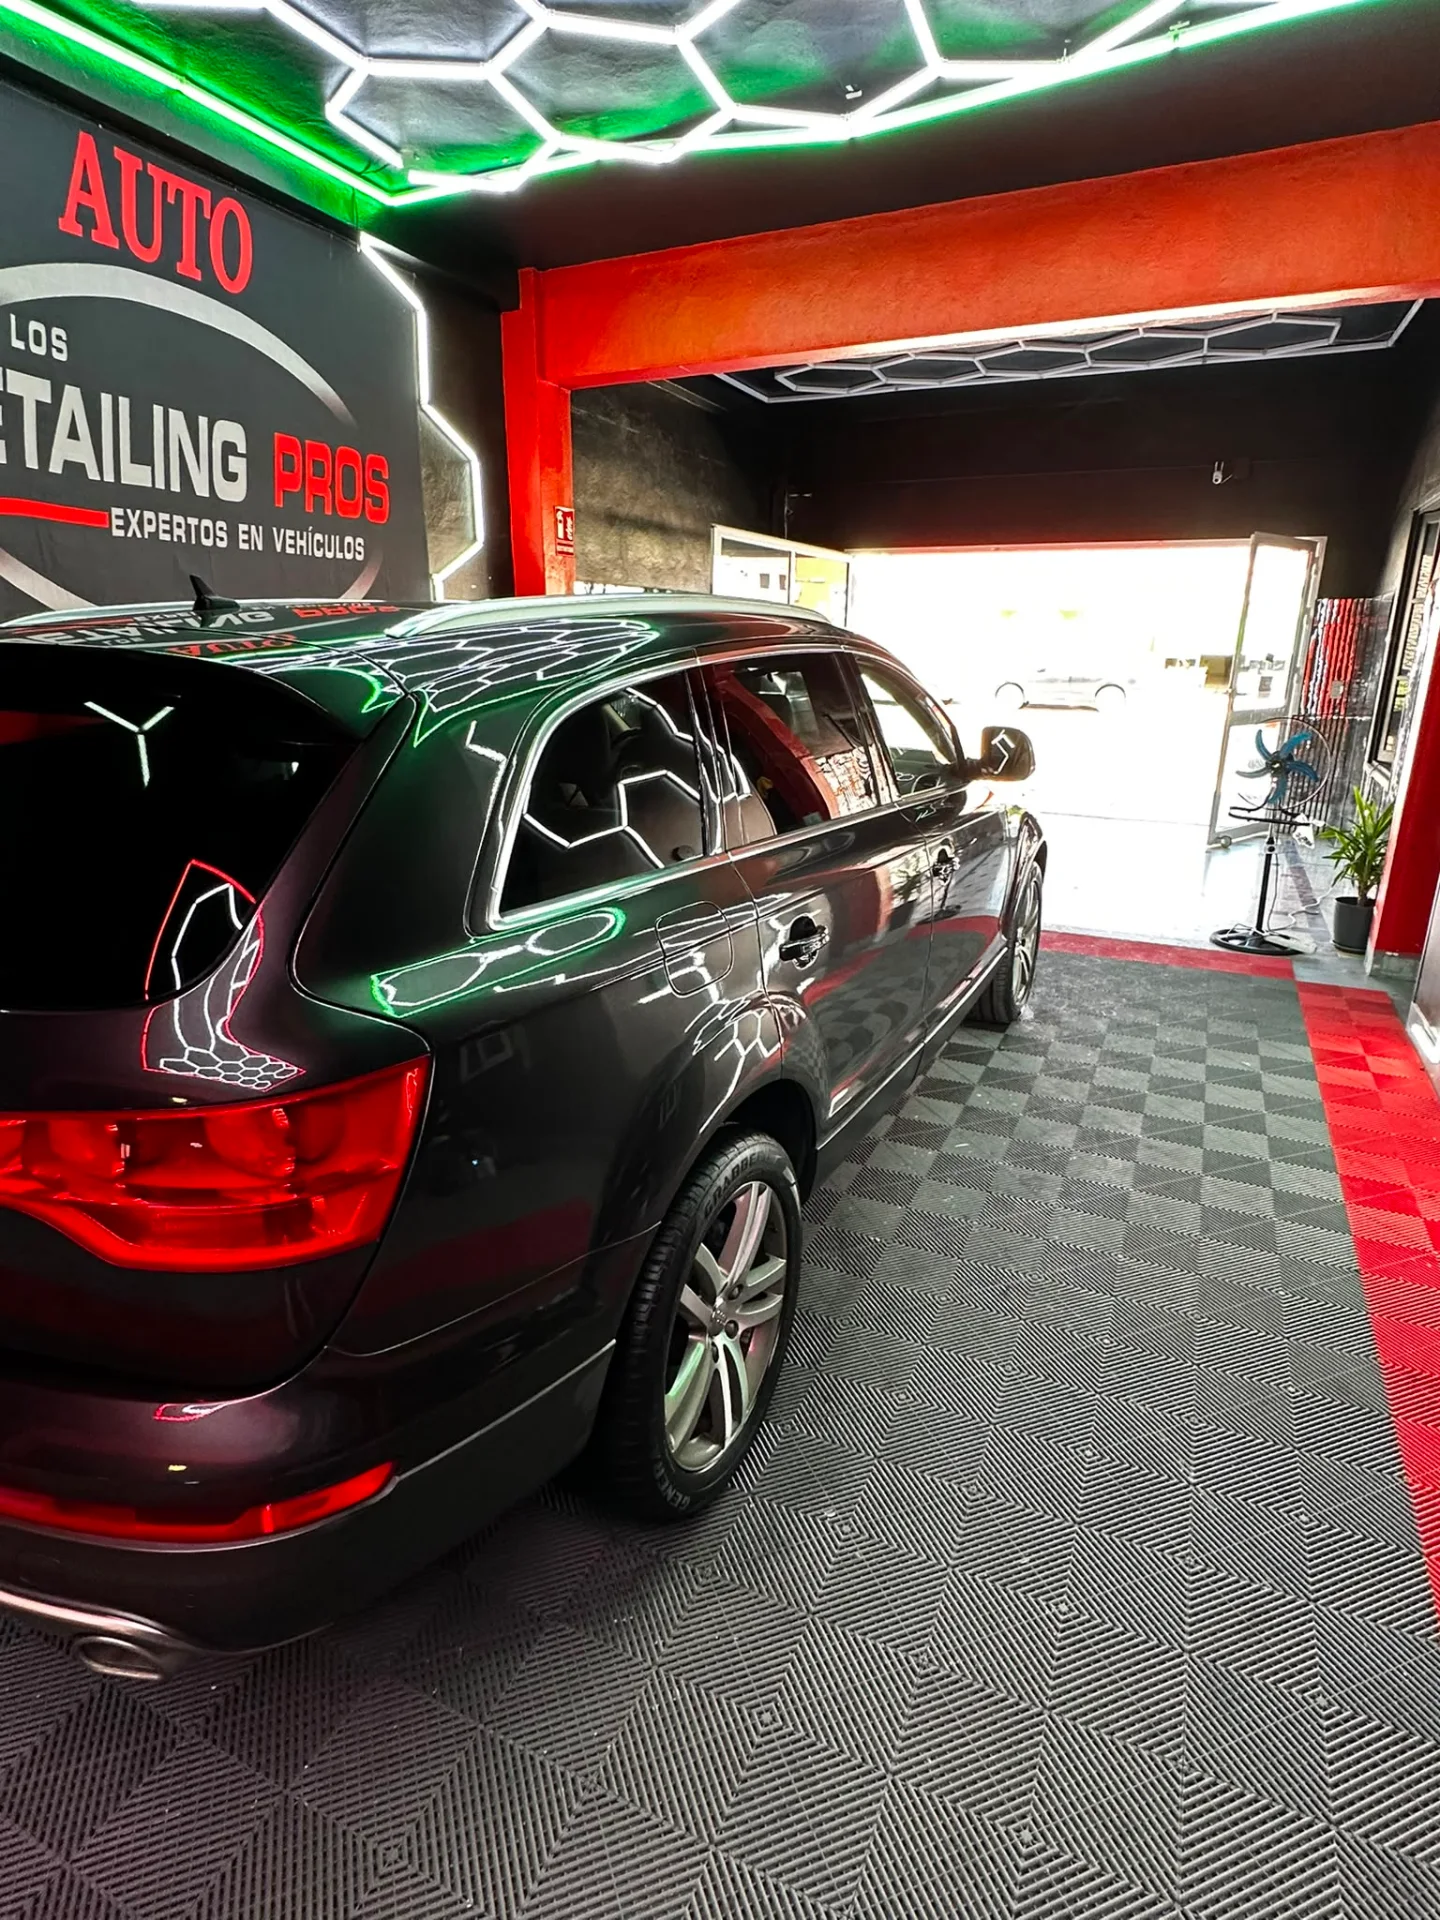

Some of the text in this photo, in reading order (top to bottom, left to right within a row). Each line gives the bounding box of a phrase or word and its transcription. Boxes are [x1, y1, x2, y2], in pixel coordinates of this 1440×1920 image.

[58, 130, 253, 294] AUTO
[10, 313, 68, 361] LOS
[0, 366, 390, 524] TAILING PROS
[111, 507, 365, 561] EXPERTOS EN VEHÍCULOS
